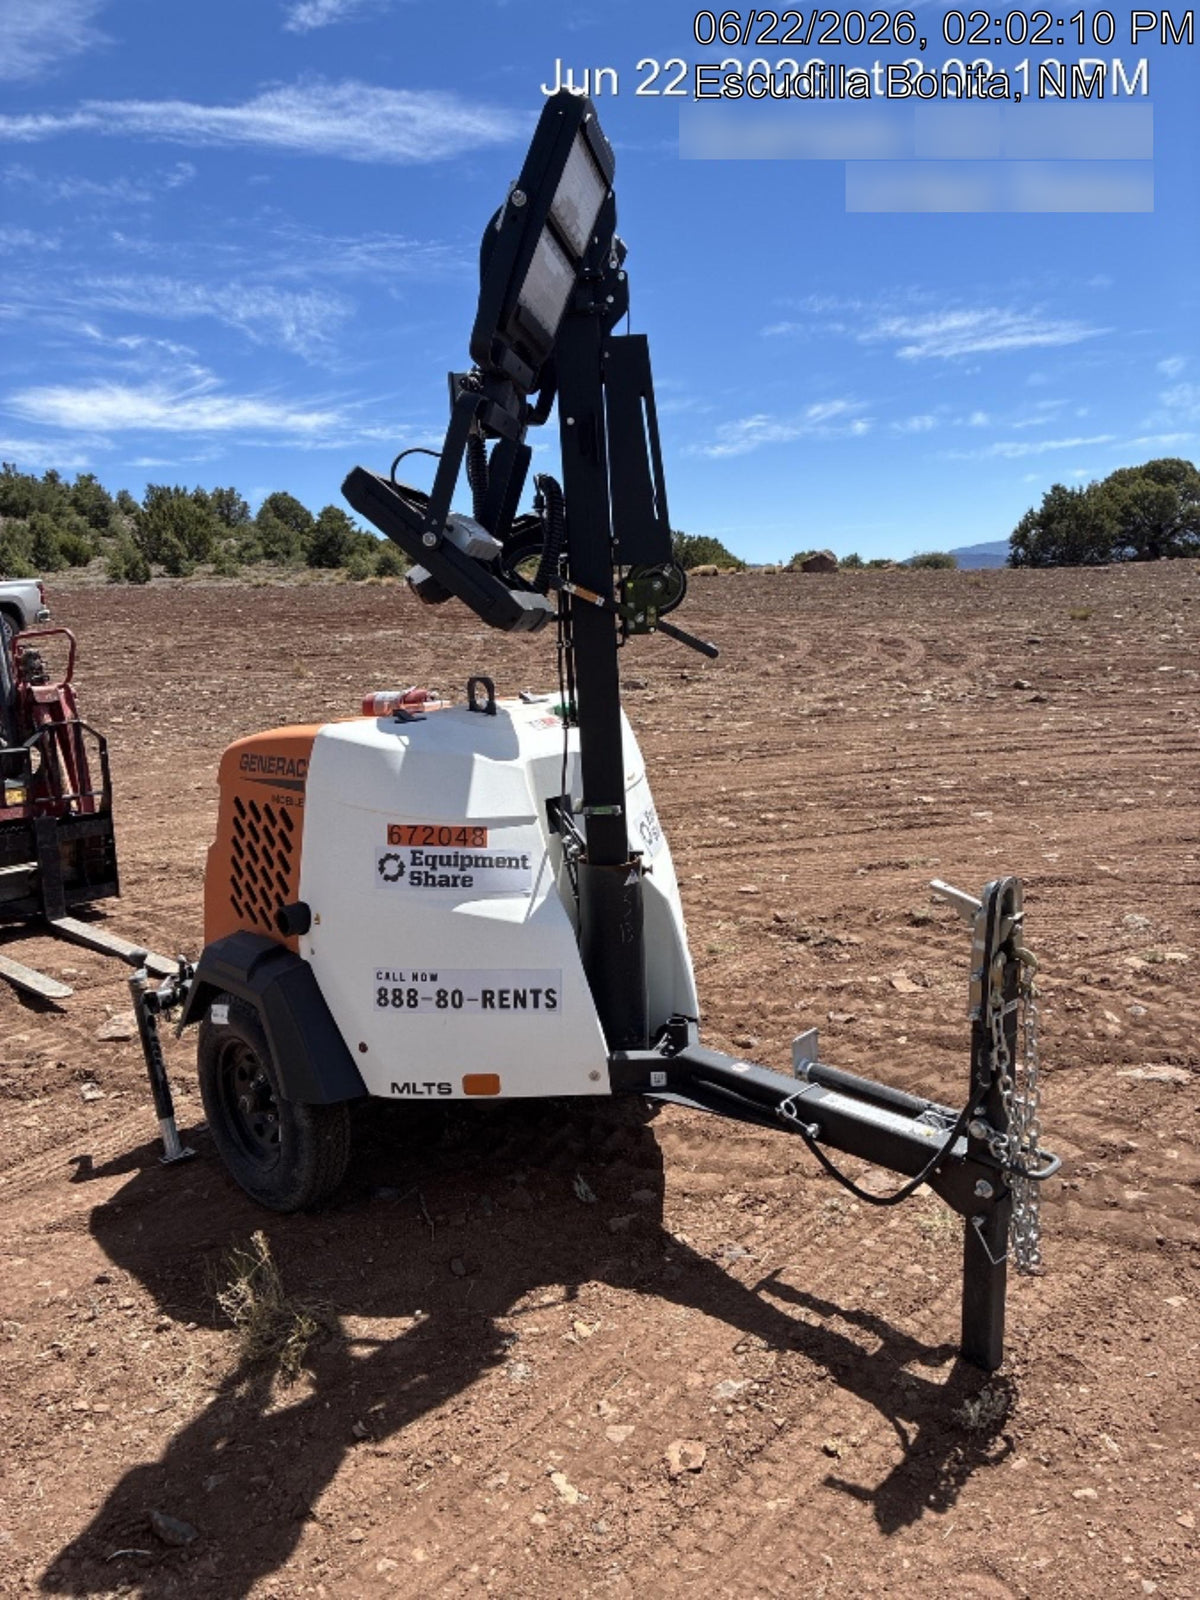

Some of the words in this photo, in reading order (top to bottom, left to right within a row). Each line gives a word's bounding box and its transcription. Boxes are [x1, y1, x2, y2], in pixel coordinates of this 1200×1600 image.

[239, 753, 308, 778] GENERAC
[389, 824, 485, 848] 672048
[410, 849, 531, 872] Equipment
[409, 870, 474, 888] Share
[376, 971, 406, 982] CALL
[412, 972, 438, 983] NOW
[376, 986, 558, 1010] 888-80-RENTS
[391, 1081, 453, 1096] MLTS
